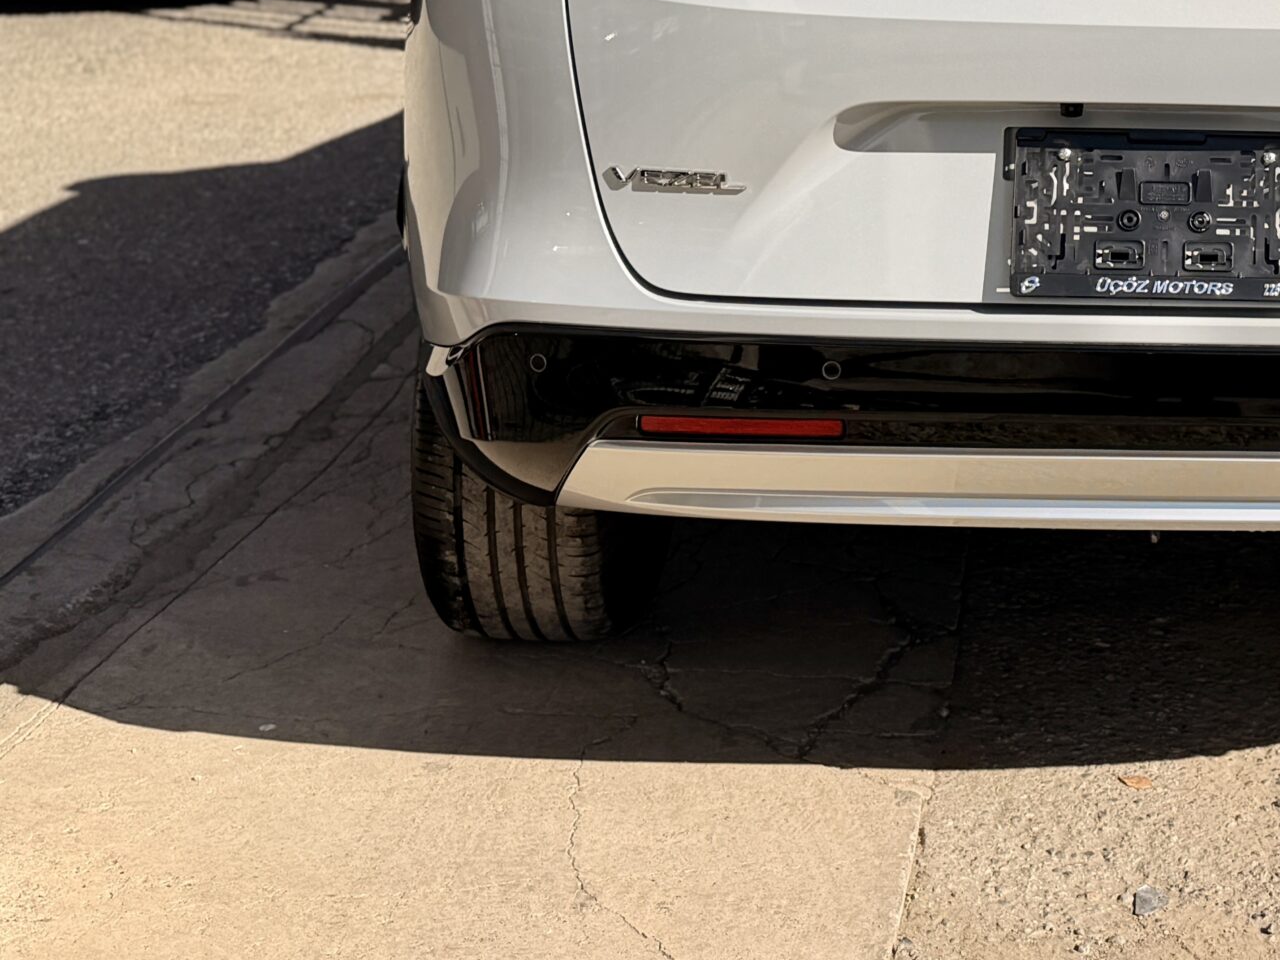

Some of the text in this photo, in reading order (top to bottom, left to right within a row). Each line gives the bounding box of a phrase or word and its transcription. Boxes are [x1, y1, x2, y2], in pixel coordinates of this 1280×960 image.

[602, 166, 747, 195] VEZEL
[1095, 276, 1234, 296] ÜÇÖZ MOTORS
